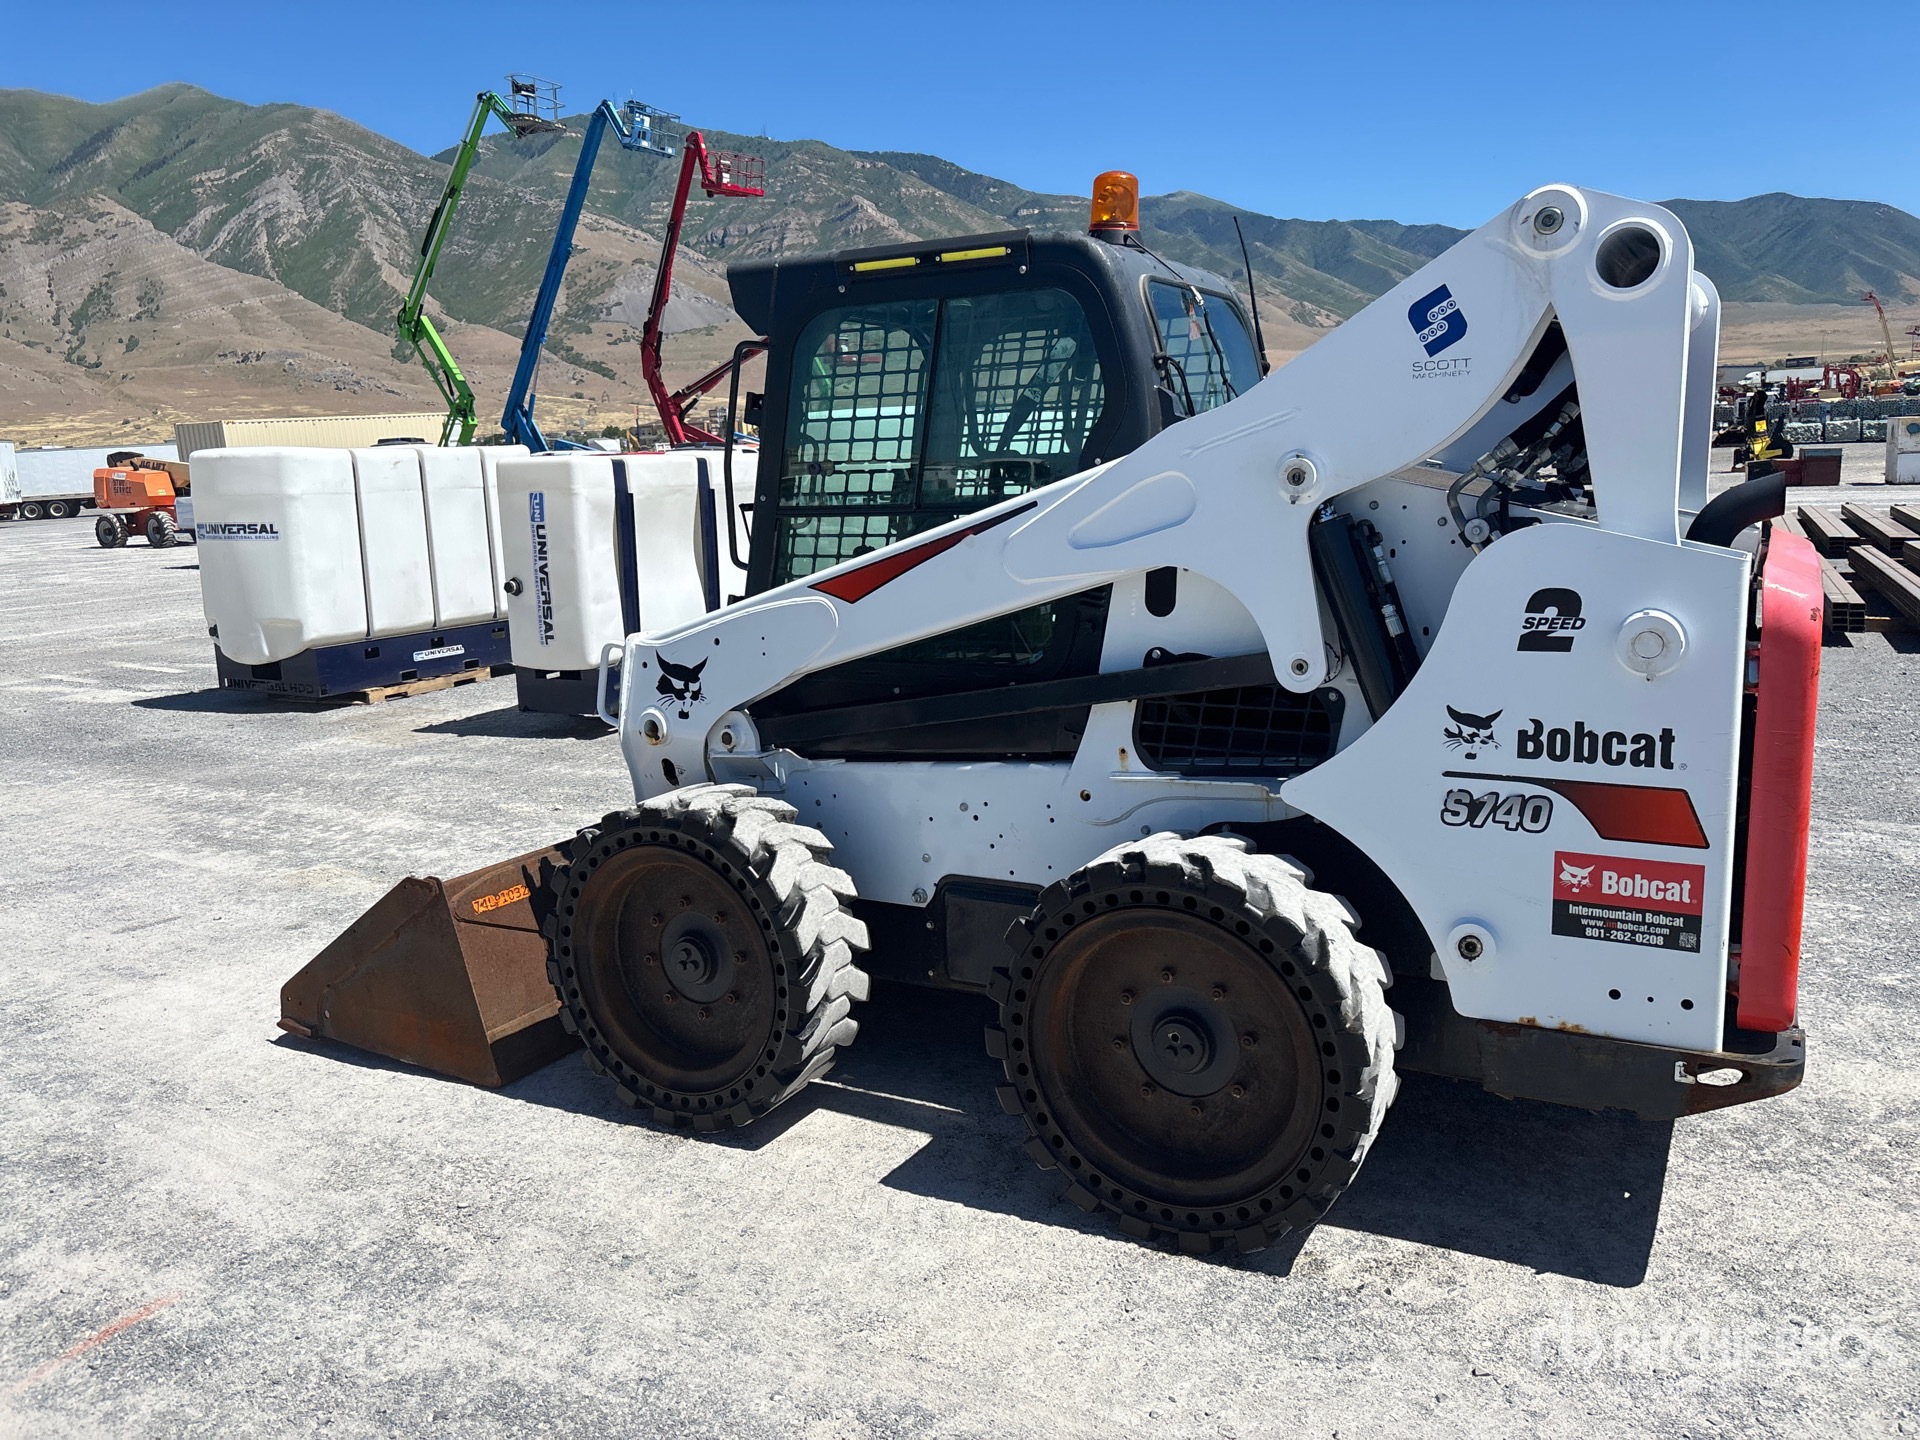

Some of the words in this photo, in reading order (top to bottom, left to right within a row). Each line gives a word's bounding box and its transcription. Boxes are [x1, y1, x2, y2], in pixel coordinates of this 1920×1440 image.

[1412, 357, 1472, 372] SCOTT
[152, 461, 167, 471] LIFT
[205, 523, 279, 535] UNIVERSAL
[530, 524, 538, 566] HORIZONTAL
[534, 568, 542, 612] DIRECTIONAL
[535, 524, 555, 645] UNIVERSAL
[1517, 587, 1582, 652] 2
[1522, 616, 1586, 631] SPEED
[424, 645, 464, 657] UNIVERSAL
[1516, 718, 1676, 770] Bobcat
[1441, 788, 1553, 834] S740
[1601, 869, 1692, 904] Bobcat
[1569, 904, 1643, 923] Intermountain
[1645, 914, 1685, 928] Bobcat
[1585, 927, 1664, 946] 801-262-0208
